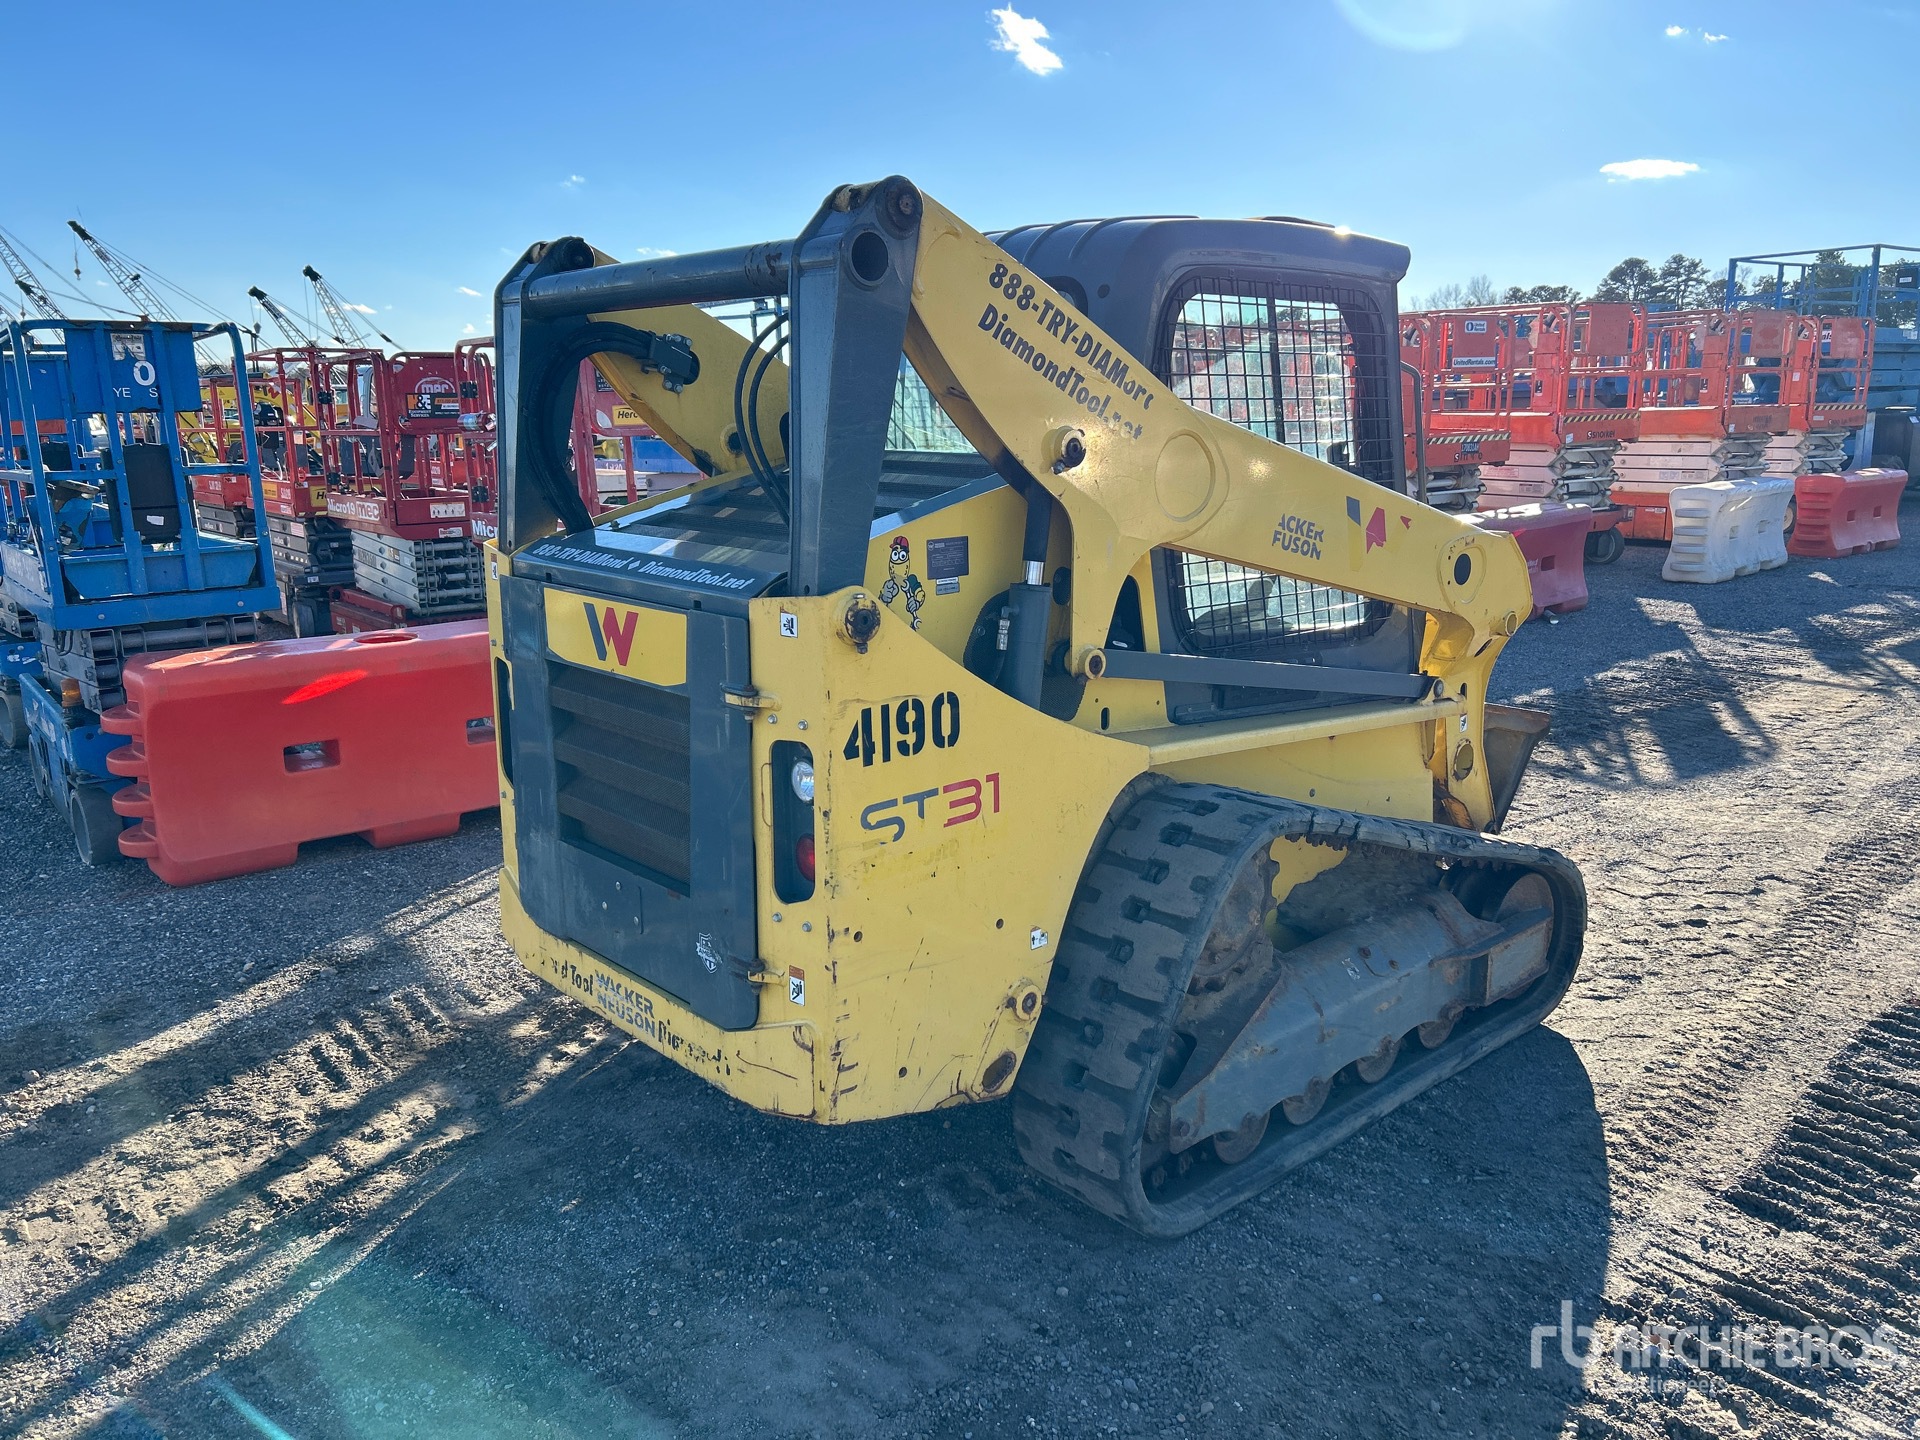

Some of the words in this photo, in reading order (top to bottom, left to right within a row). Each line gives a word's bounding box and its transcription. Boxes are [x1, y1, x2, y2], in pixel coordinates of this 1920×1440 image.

[532, 543, 630, 567] 888-TRY-DIAMond
[638, 561, 754, 590] DiamondTool.net
[843, 691, 961, 767] 4190
[860, 772, 1000, 845] ST31
